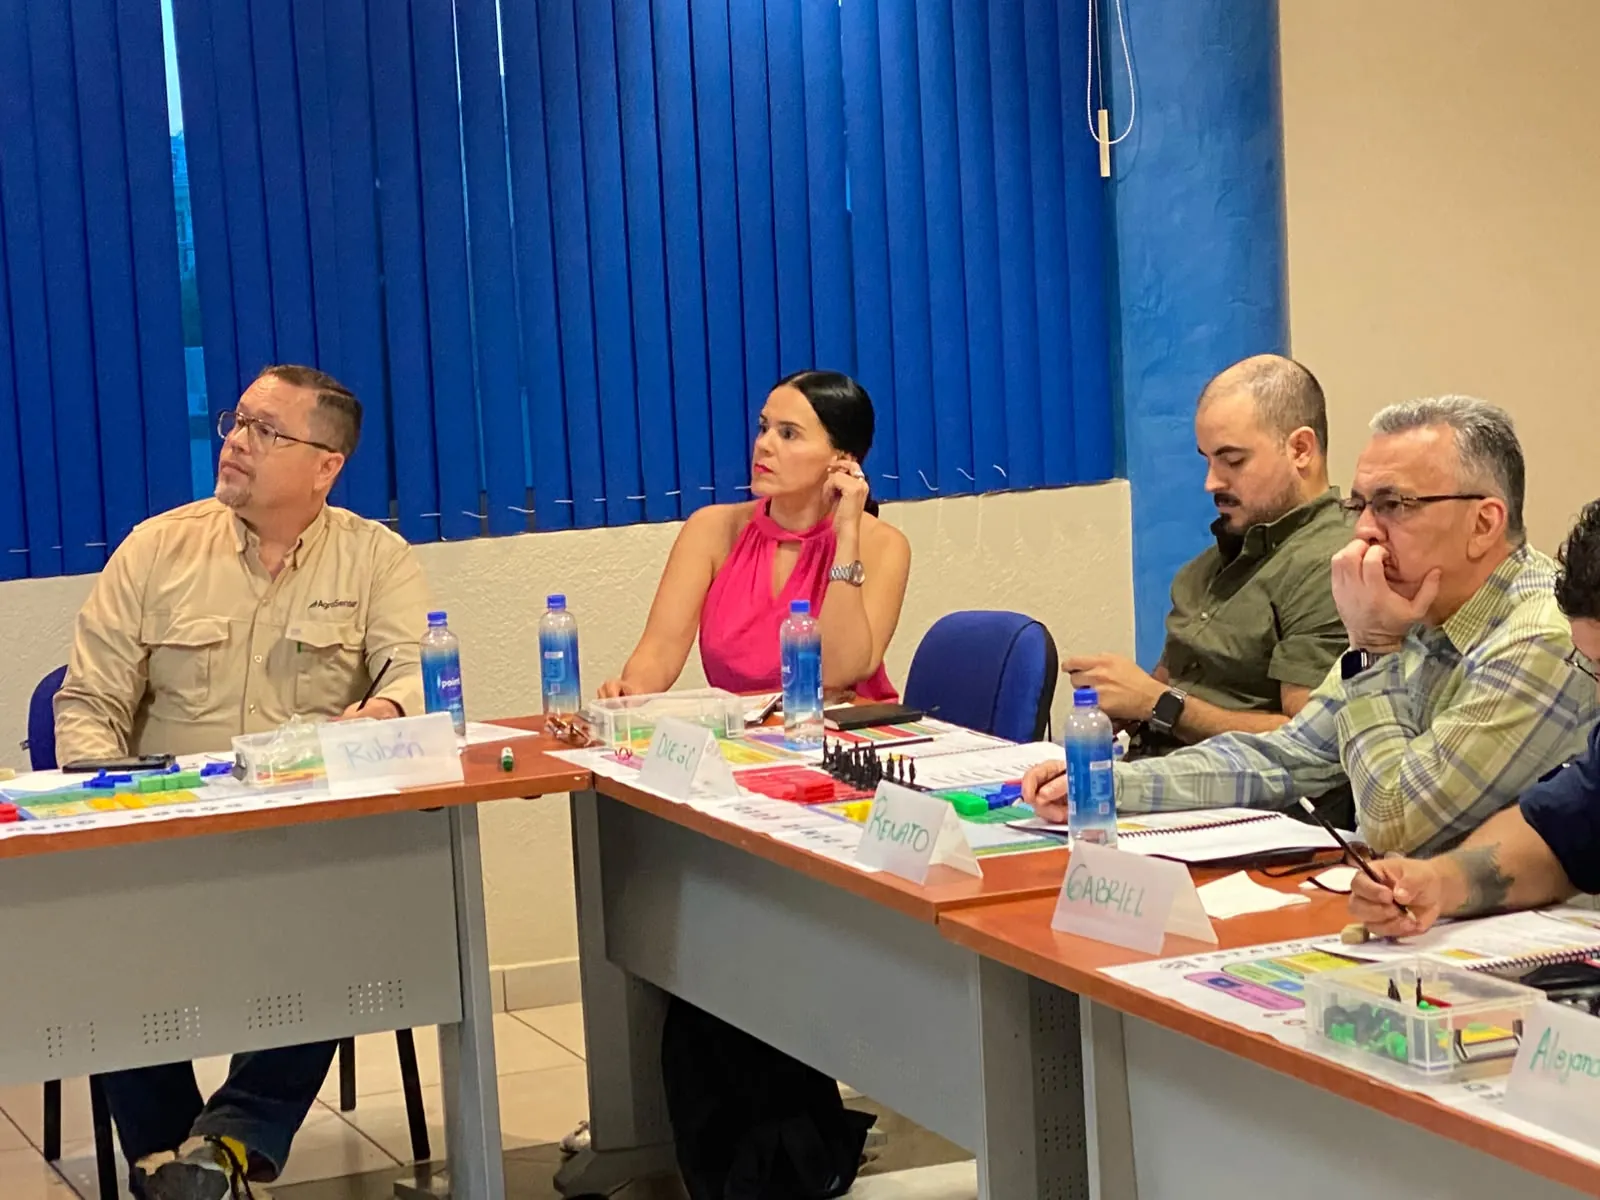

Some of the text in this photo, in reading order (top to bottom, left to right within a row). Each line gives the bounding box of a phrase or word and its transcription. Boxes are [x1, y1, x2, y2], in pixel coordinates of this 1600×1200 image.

[337, 731, 424, 770] Rubén
[868, 796, 930, 853] RENATO
[1066, 864, 1144, 917] GABRIEL
